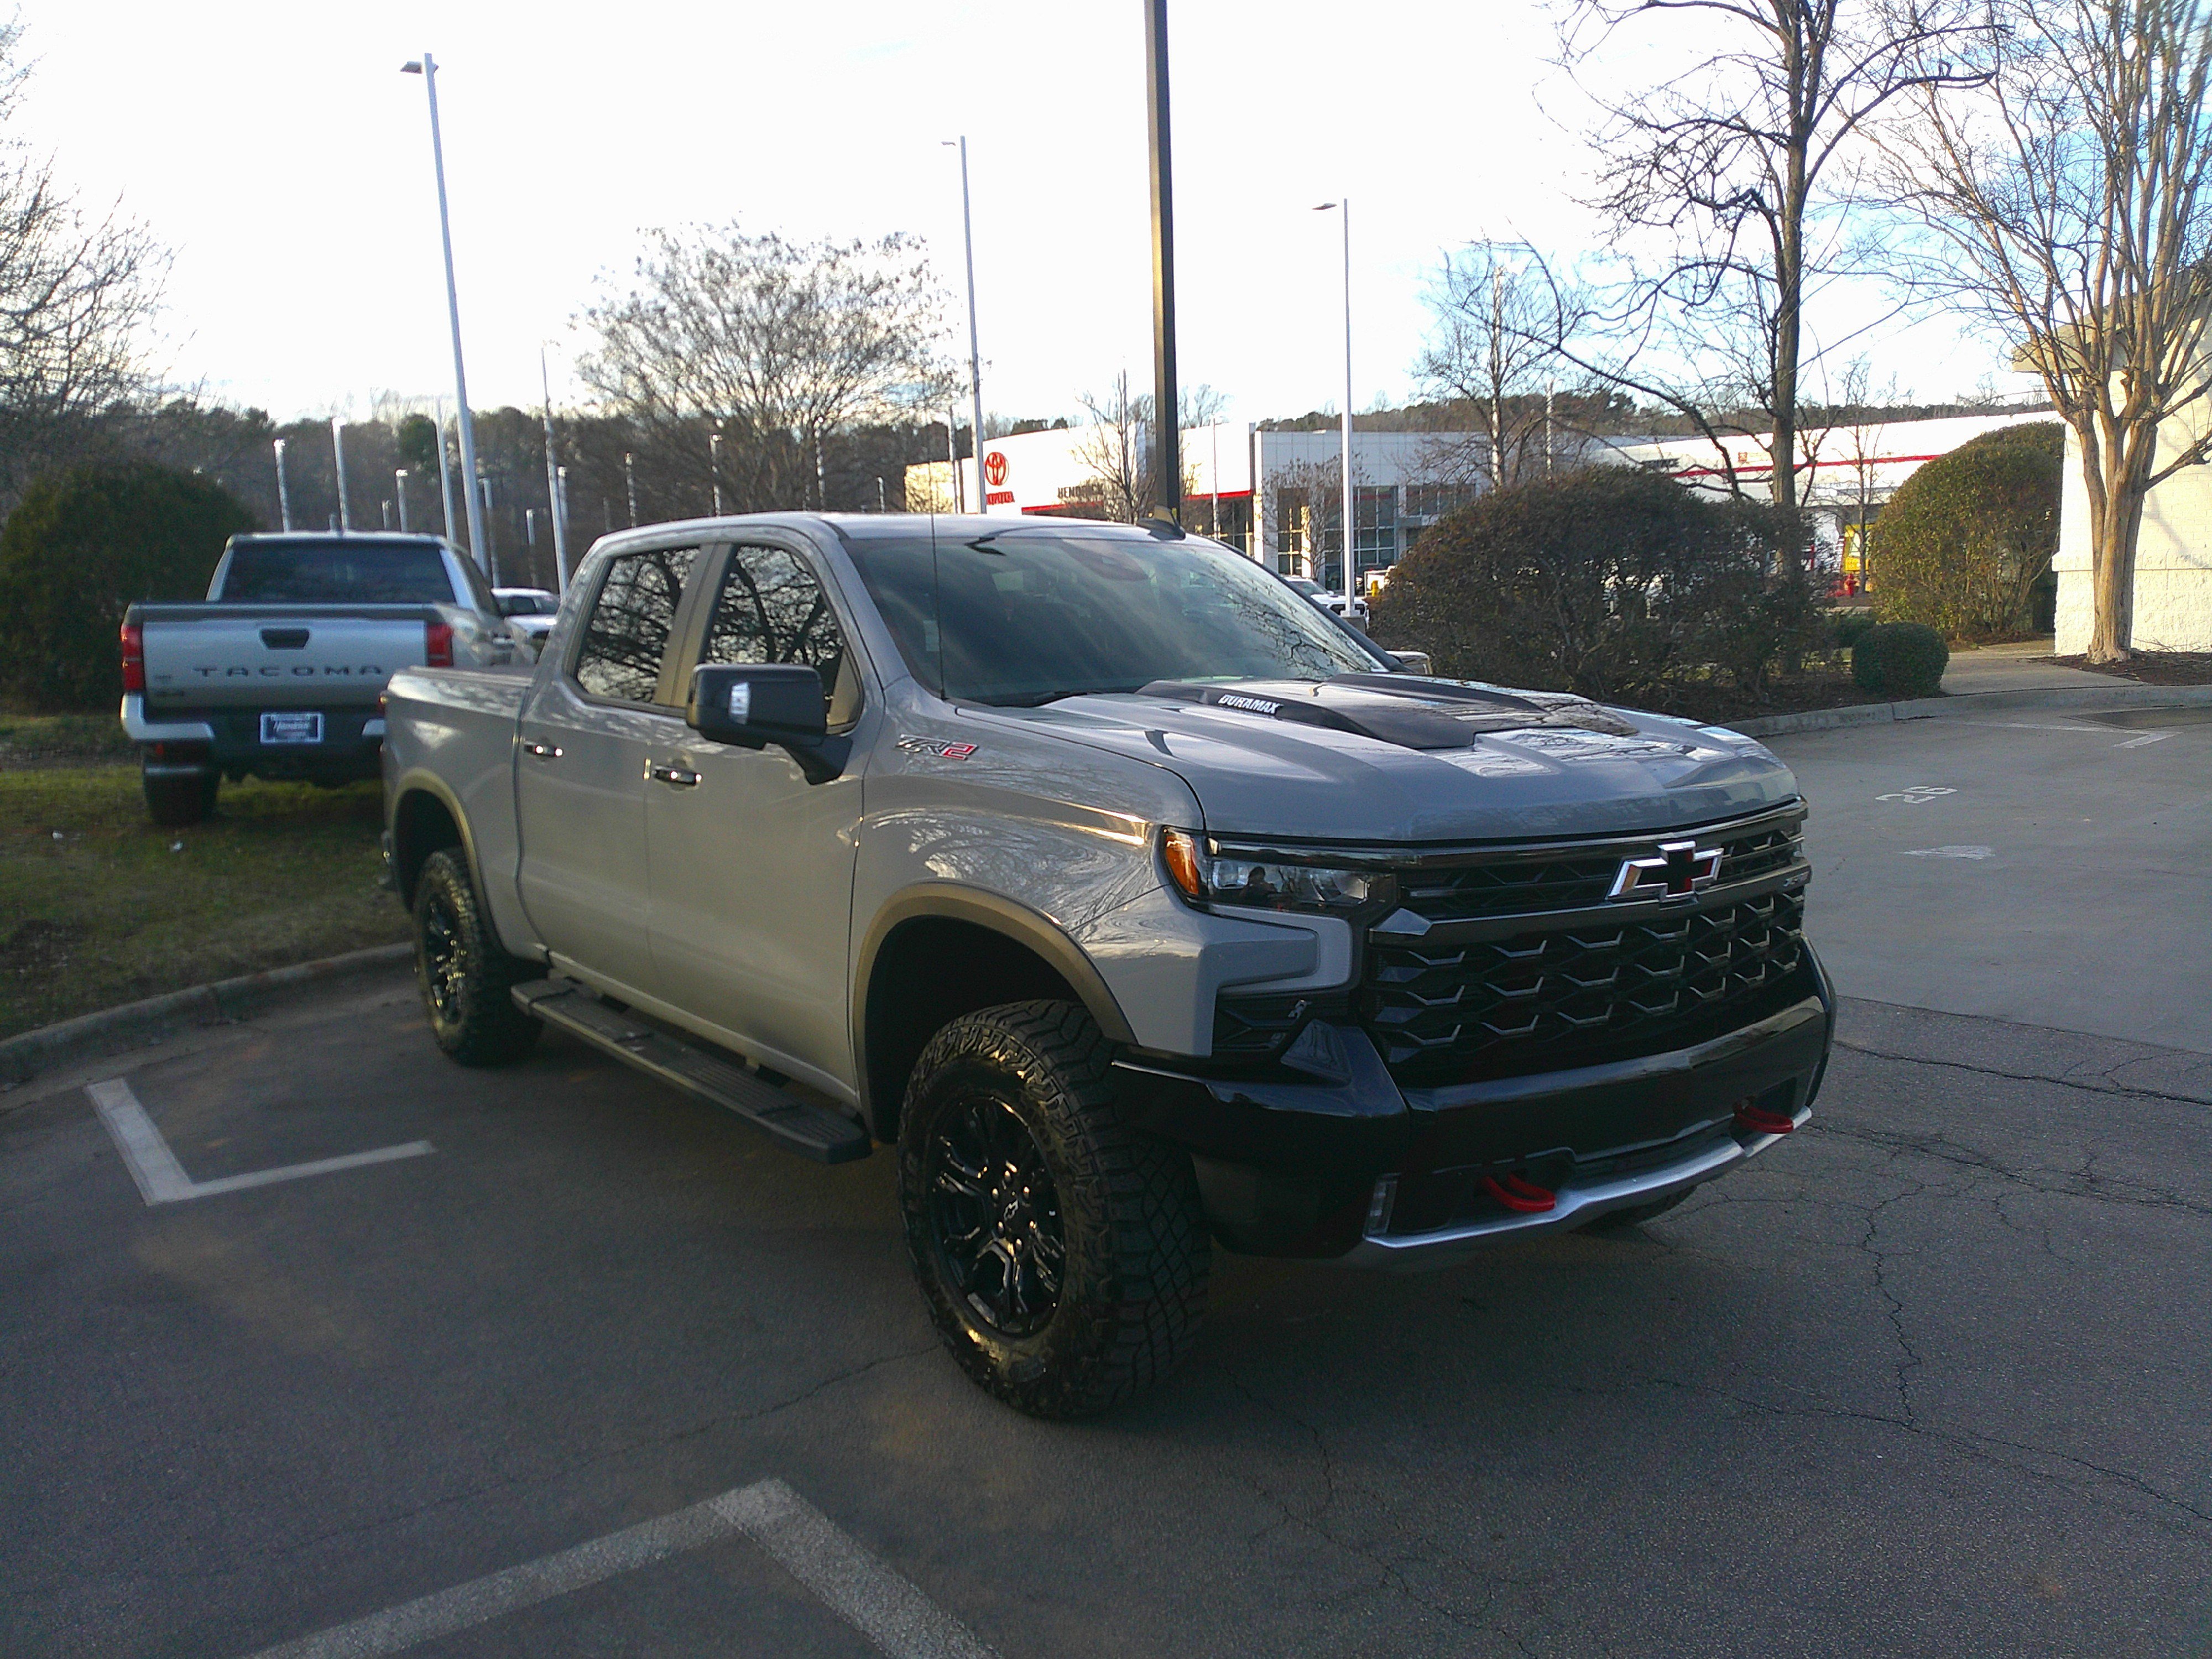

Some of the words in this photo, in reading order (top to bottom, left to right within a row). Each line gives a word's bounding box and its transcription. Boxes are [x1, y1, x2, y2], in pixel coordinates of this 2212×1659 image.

[194, 665, 383, 677] TACOMA
[1218, 693, 1284, 714] DURAMAX
[895, 734, 978, 760] ZR2
